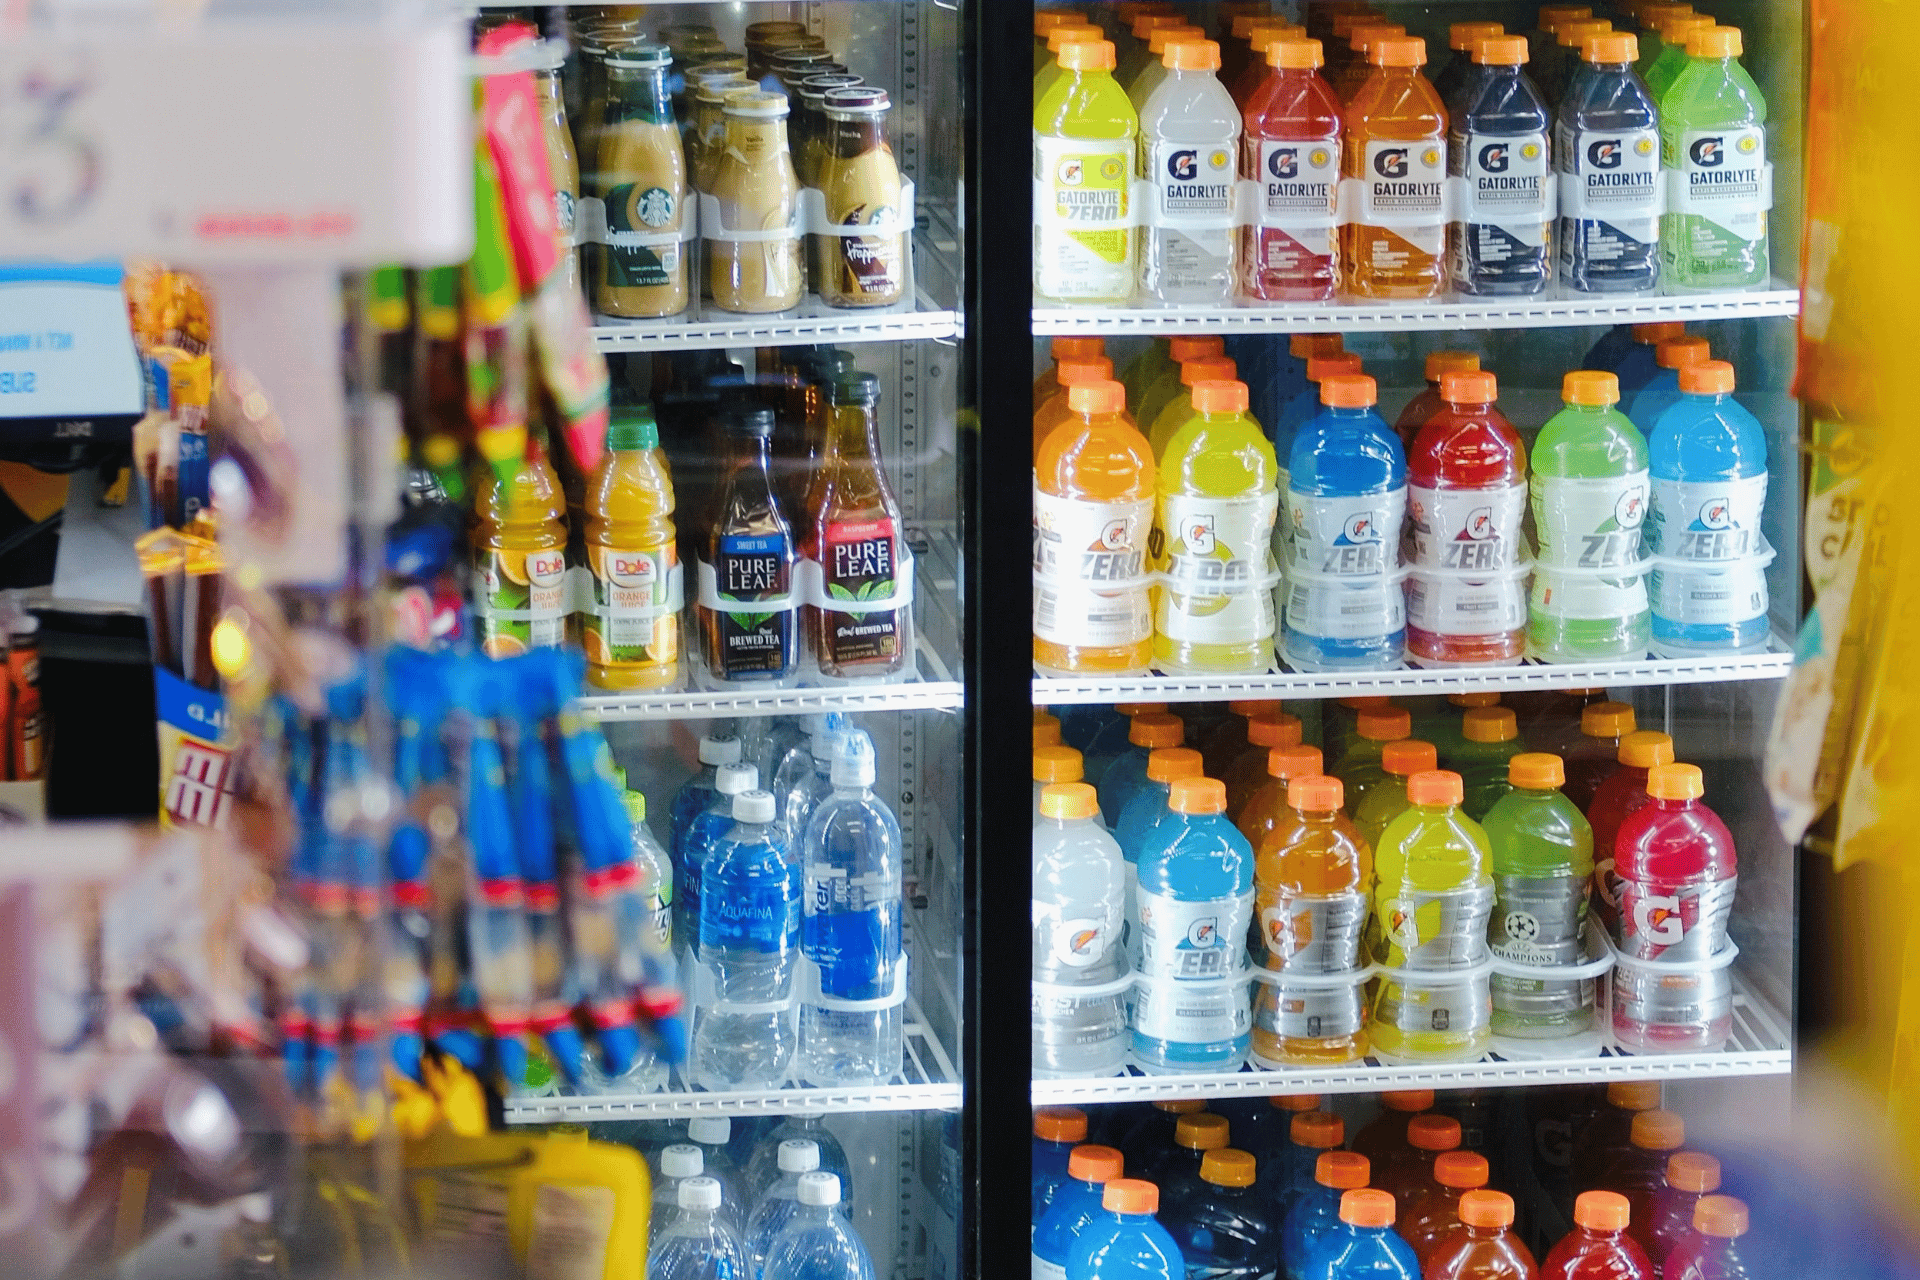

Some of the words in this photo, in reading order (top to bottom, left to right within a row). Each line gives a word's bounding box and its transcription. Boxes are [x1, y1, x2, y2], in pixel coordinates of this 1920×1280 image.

[1478, 176, 1540, 189] GATORLYTE
[1587, 172, 1653, 186] GATORLYTE
[1690, 169, 1757, 184] GATORLYTE
[1167, 184, 1228, 198] GATORLYTE
[1268, 183, 1328, 196] GATORLYTE
[1373, 182, 1442, 195] GATORLYTE
[1057, 190, 1119, 204] GATORLYTE
[736, 541, 755, 550] SWEET
[756, 540, 767, 549] TEA
[835, 541, 888, 561] PURE
[615, 559, 650, 574] Dole
[728, 558, 776, 574] PURE
[1080, 550, 1141, 581] ZERO
[613, 592, 648, 601] ORANGE
[855, 624, 881, 636] BREWED
[882, 623, 894, 633] TEA
[729, 635, 763, 647] BREWED
[764, 634, 780, 645] TEA
[720, 905, 774, 920] AQUAFINA
[1633, 895, 1684, 945] G
[1493, 948, 1552, 962] CHAMPIONS
